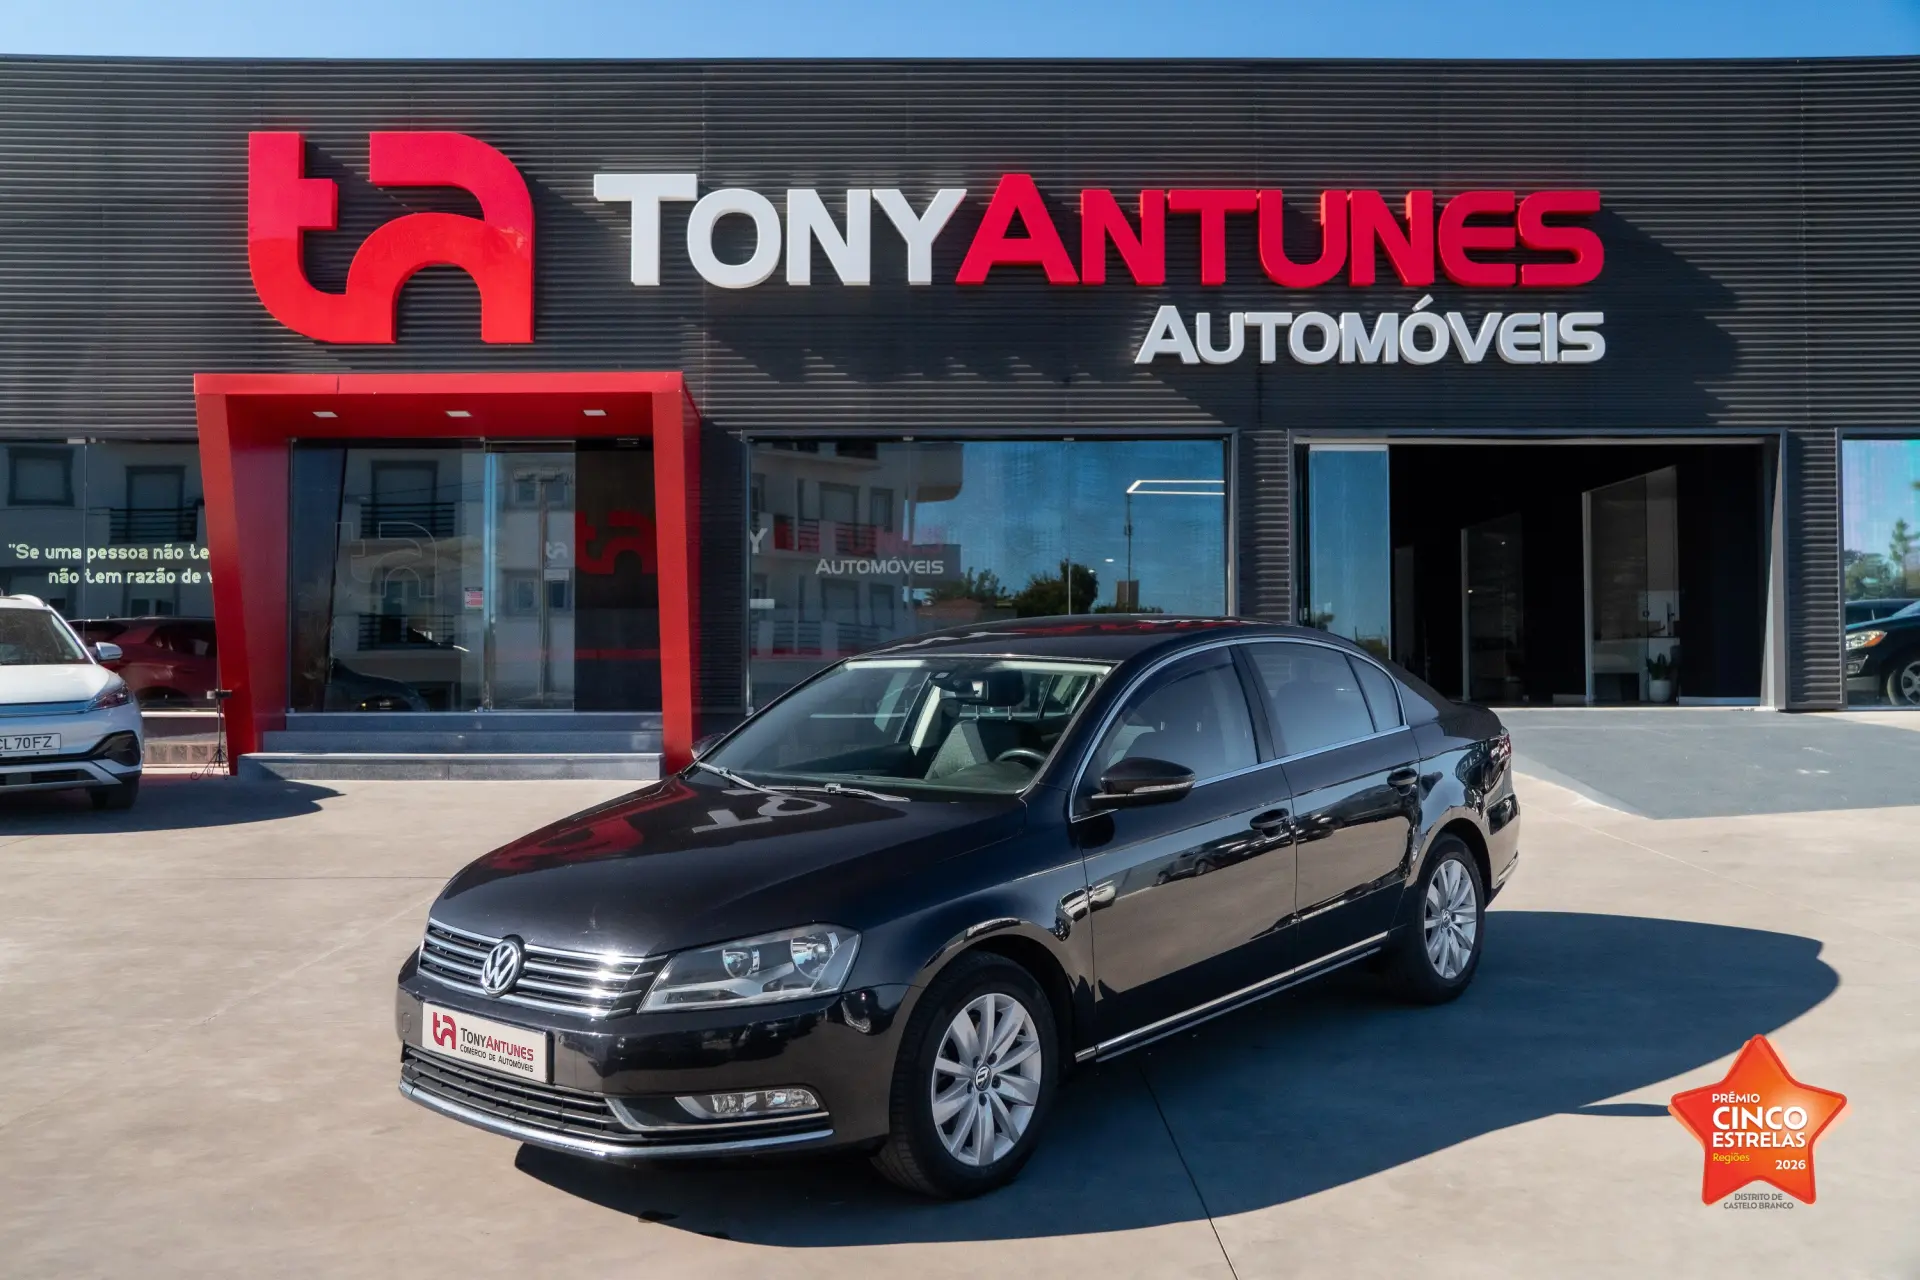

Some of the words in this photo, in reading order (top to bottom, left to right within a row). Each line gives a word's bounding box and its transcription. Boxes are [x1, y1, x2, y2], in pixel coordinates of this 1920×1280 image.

[1134, 293, 1605, 365] AUTOMÓVEIS
[8, 543, 40, 560] "Se
[45, 547, 82, 560] uma
[87, 547, 149, 564] pessoa
[153, 543, 184, 560] não
[48, 568, 80, 584] não
[85, 568, 122, 584] tem
[127, 568, 176, 584] razão
[181, 567, 202, 584] de
[815, 556, 945, 575] AUTOMÓVEIS
[488, 1053, 496, 1062] DE
[497, 1055, 534, 1073] AUTOMÓVEIS
